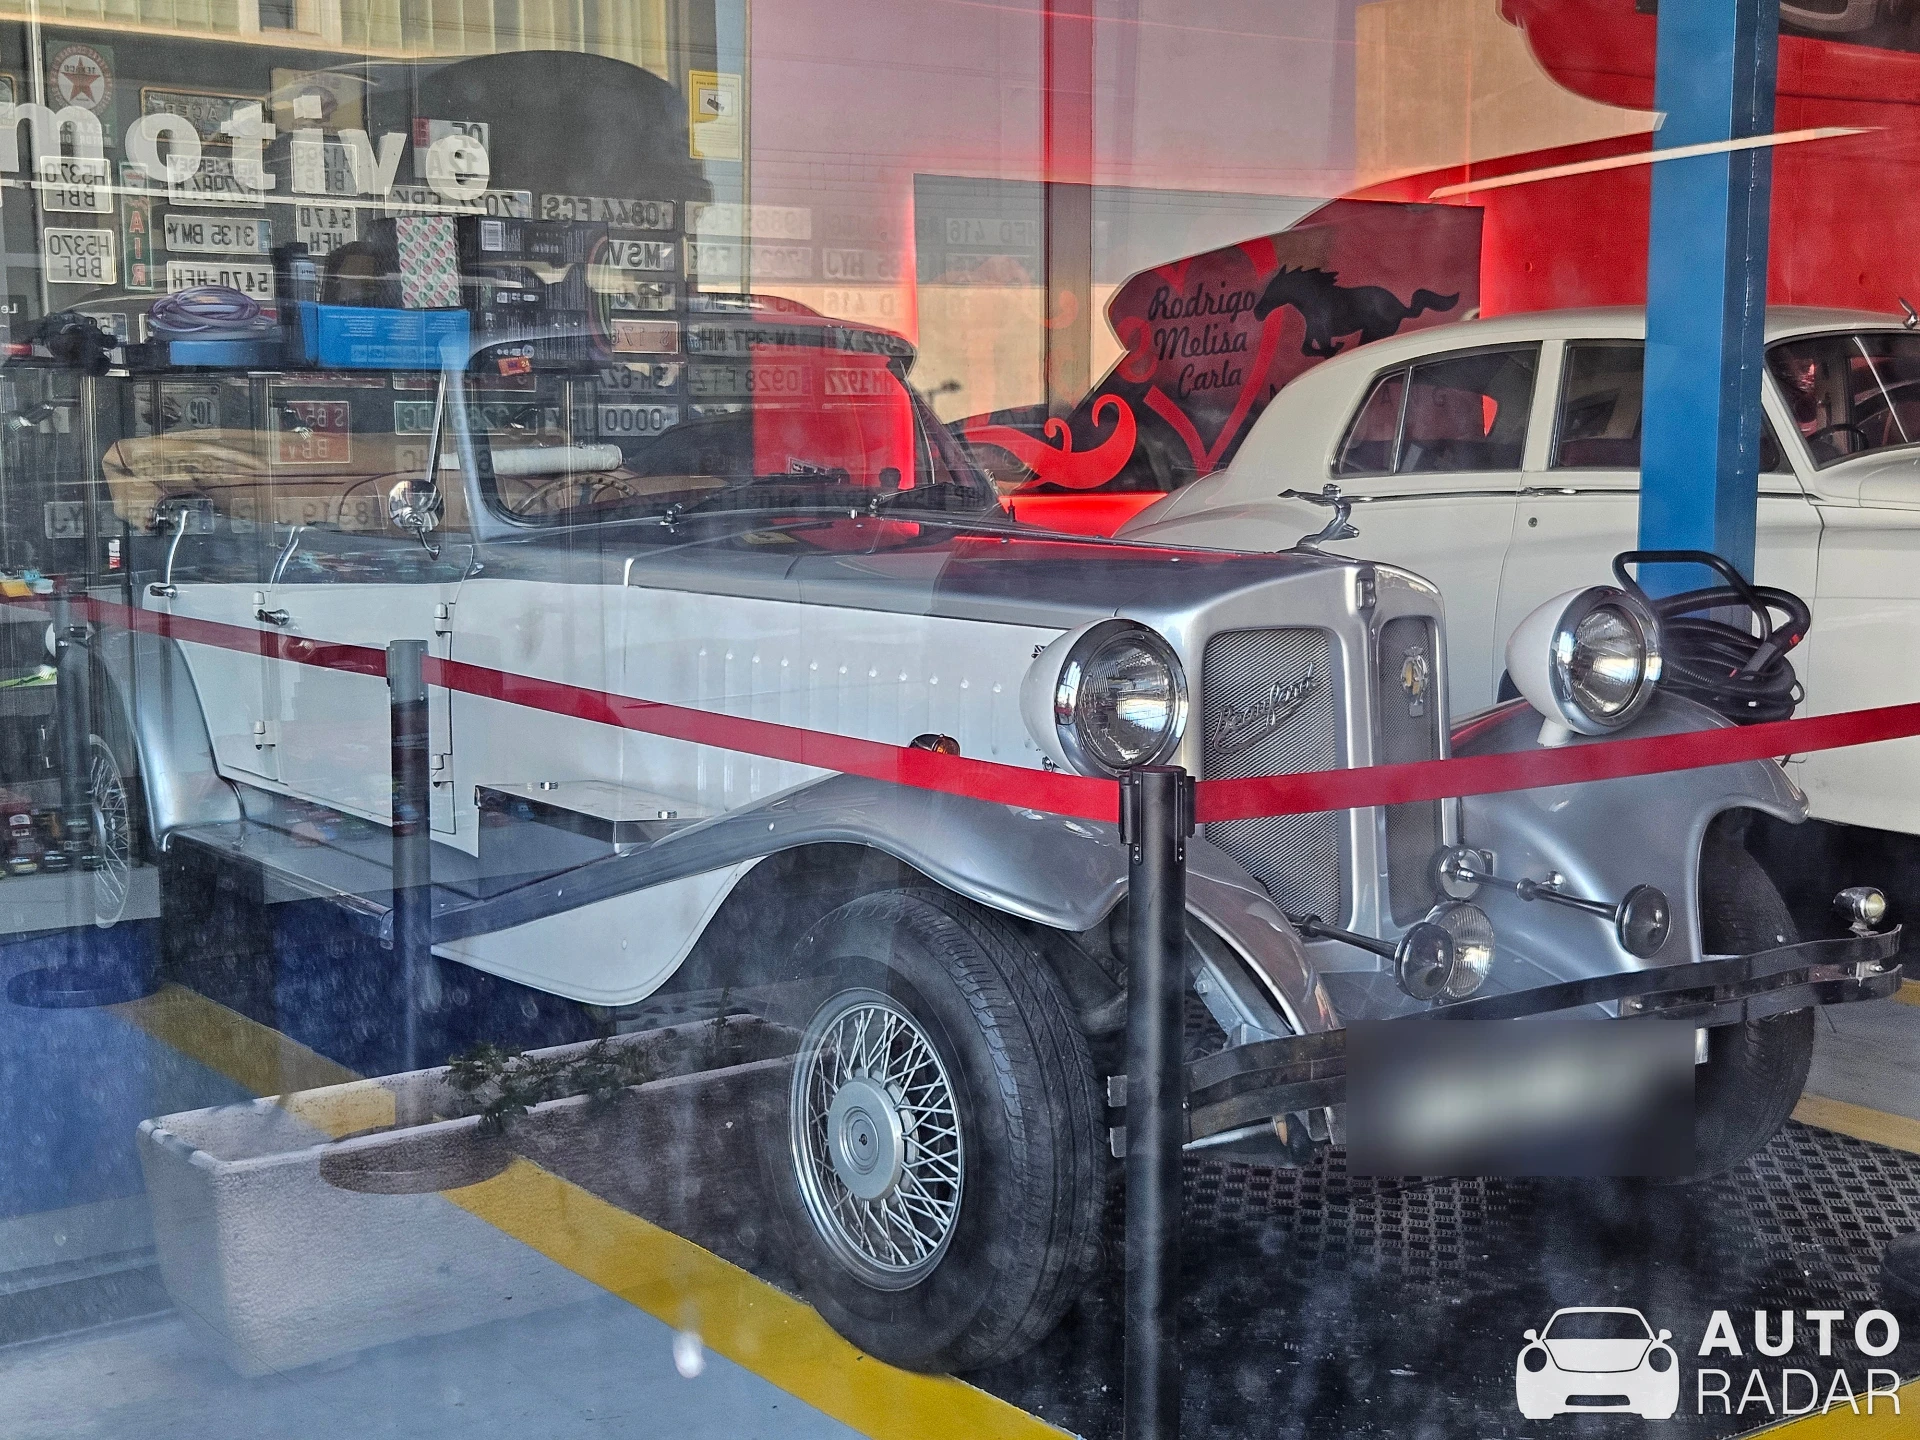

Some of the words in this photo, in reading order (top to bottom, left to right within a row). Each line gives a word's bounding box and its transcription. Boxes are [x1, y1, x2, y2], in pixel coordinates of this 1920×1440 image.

[1148, 283, 1255, 322] Rodrigo
[1154, 324, 1248, 361] Melisa
[1177, 360, 1243, 399] Carla
